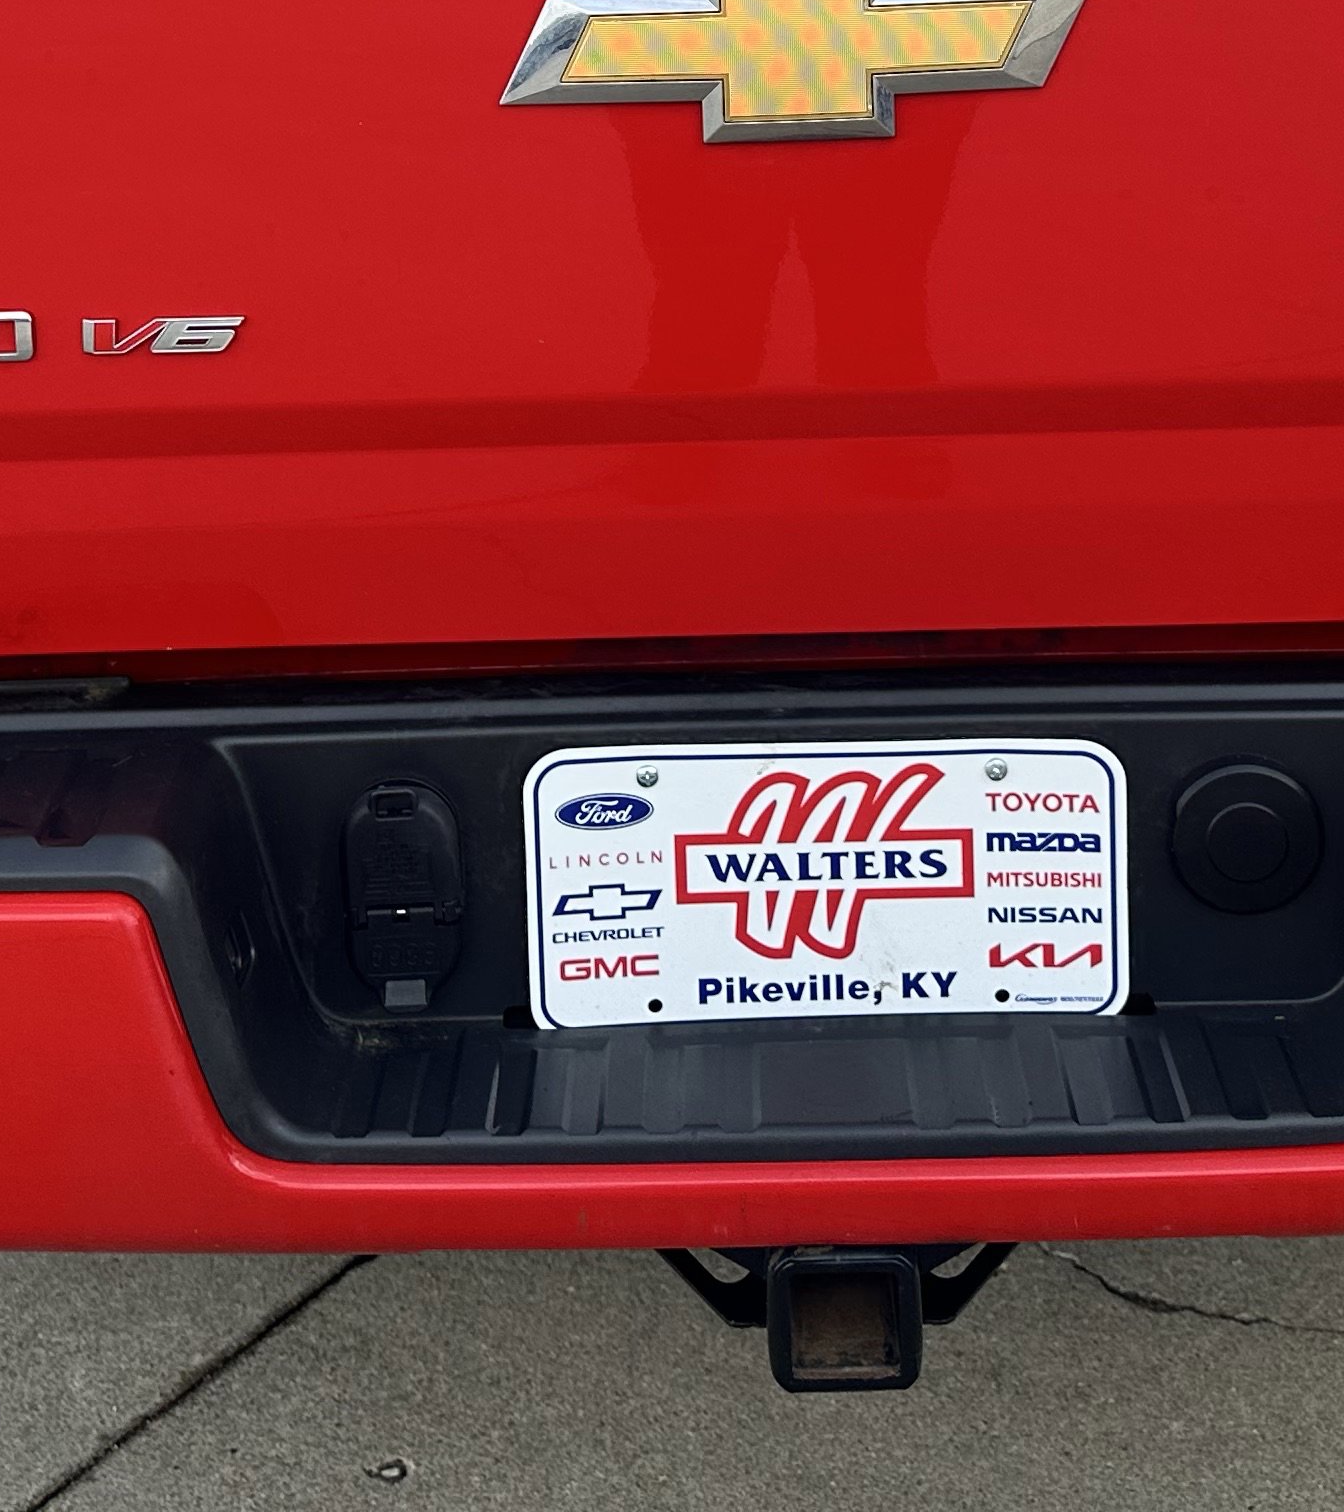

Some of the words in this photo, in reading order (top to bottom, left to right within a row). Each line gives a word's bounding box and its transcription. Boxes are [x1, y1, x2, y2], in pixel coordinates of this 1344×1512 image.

[82, 316, 245, 355] V6
[574, 799, 633, 827] Ford
[985, 792, 1100, 814] TOYOTA
[549, 850, 663, 870] LINCOLN
[705, 848, 948, 883] WALTERS
[986, 871, 1102, 889] MITSUBISHI
[987, 906, 1103, 924] NISSAN
[552, 926, 665, 944] CHEVROLET
[559, 954, 660, 981] GMC
[698, 974, 882, 1005] Pikeville,
[902, 970, 959, 1000] KY
